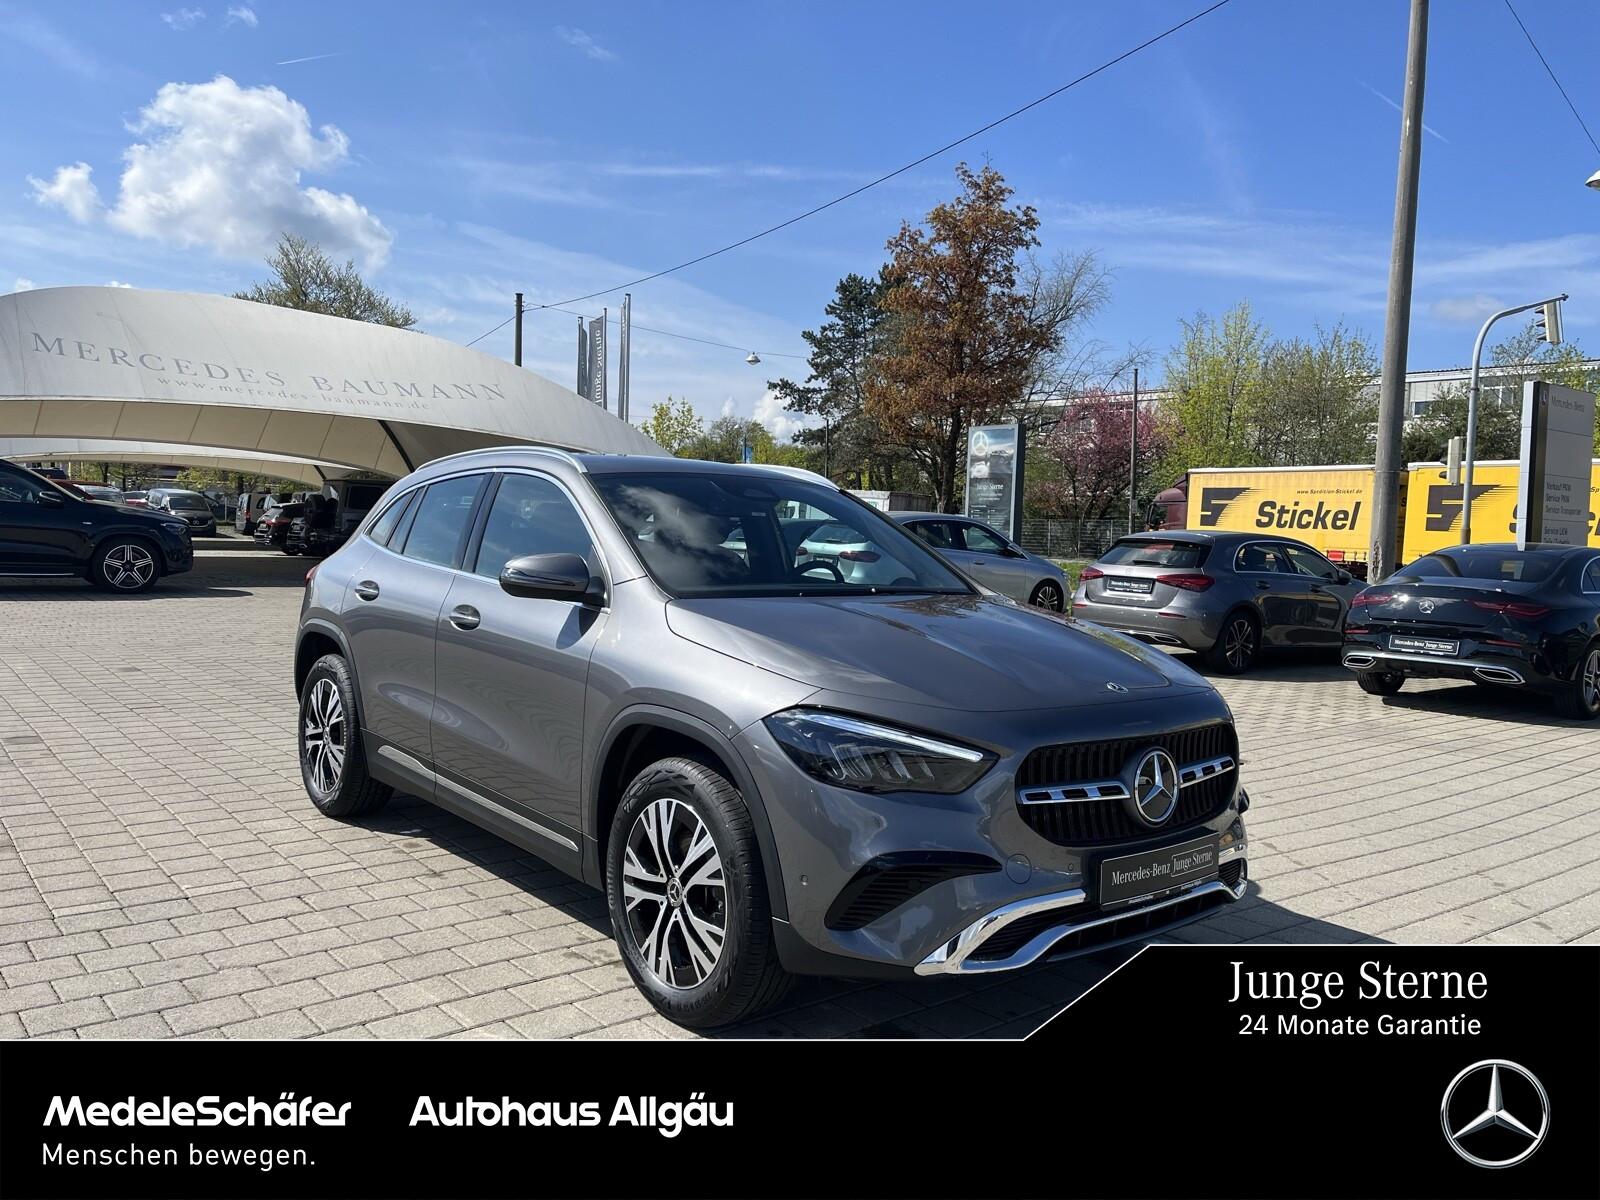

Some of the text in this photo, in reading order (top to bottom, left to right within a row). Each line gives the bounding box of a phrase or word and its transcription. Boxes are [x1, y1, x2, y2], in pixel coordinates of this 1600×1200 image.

[31, 332, 506, 400] MERCEDES BAUMANN
[1256, 500, 1361, 531] Stickel
[1112, 863, 1171, 885] Mercedes-Benz
[1173, 858, 1192, 872] Junge
[1192, 851, 1213, 865] Sterne
